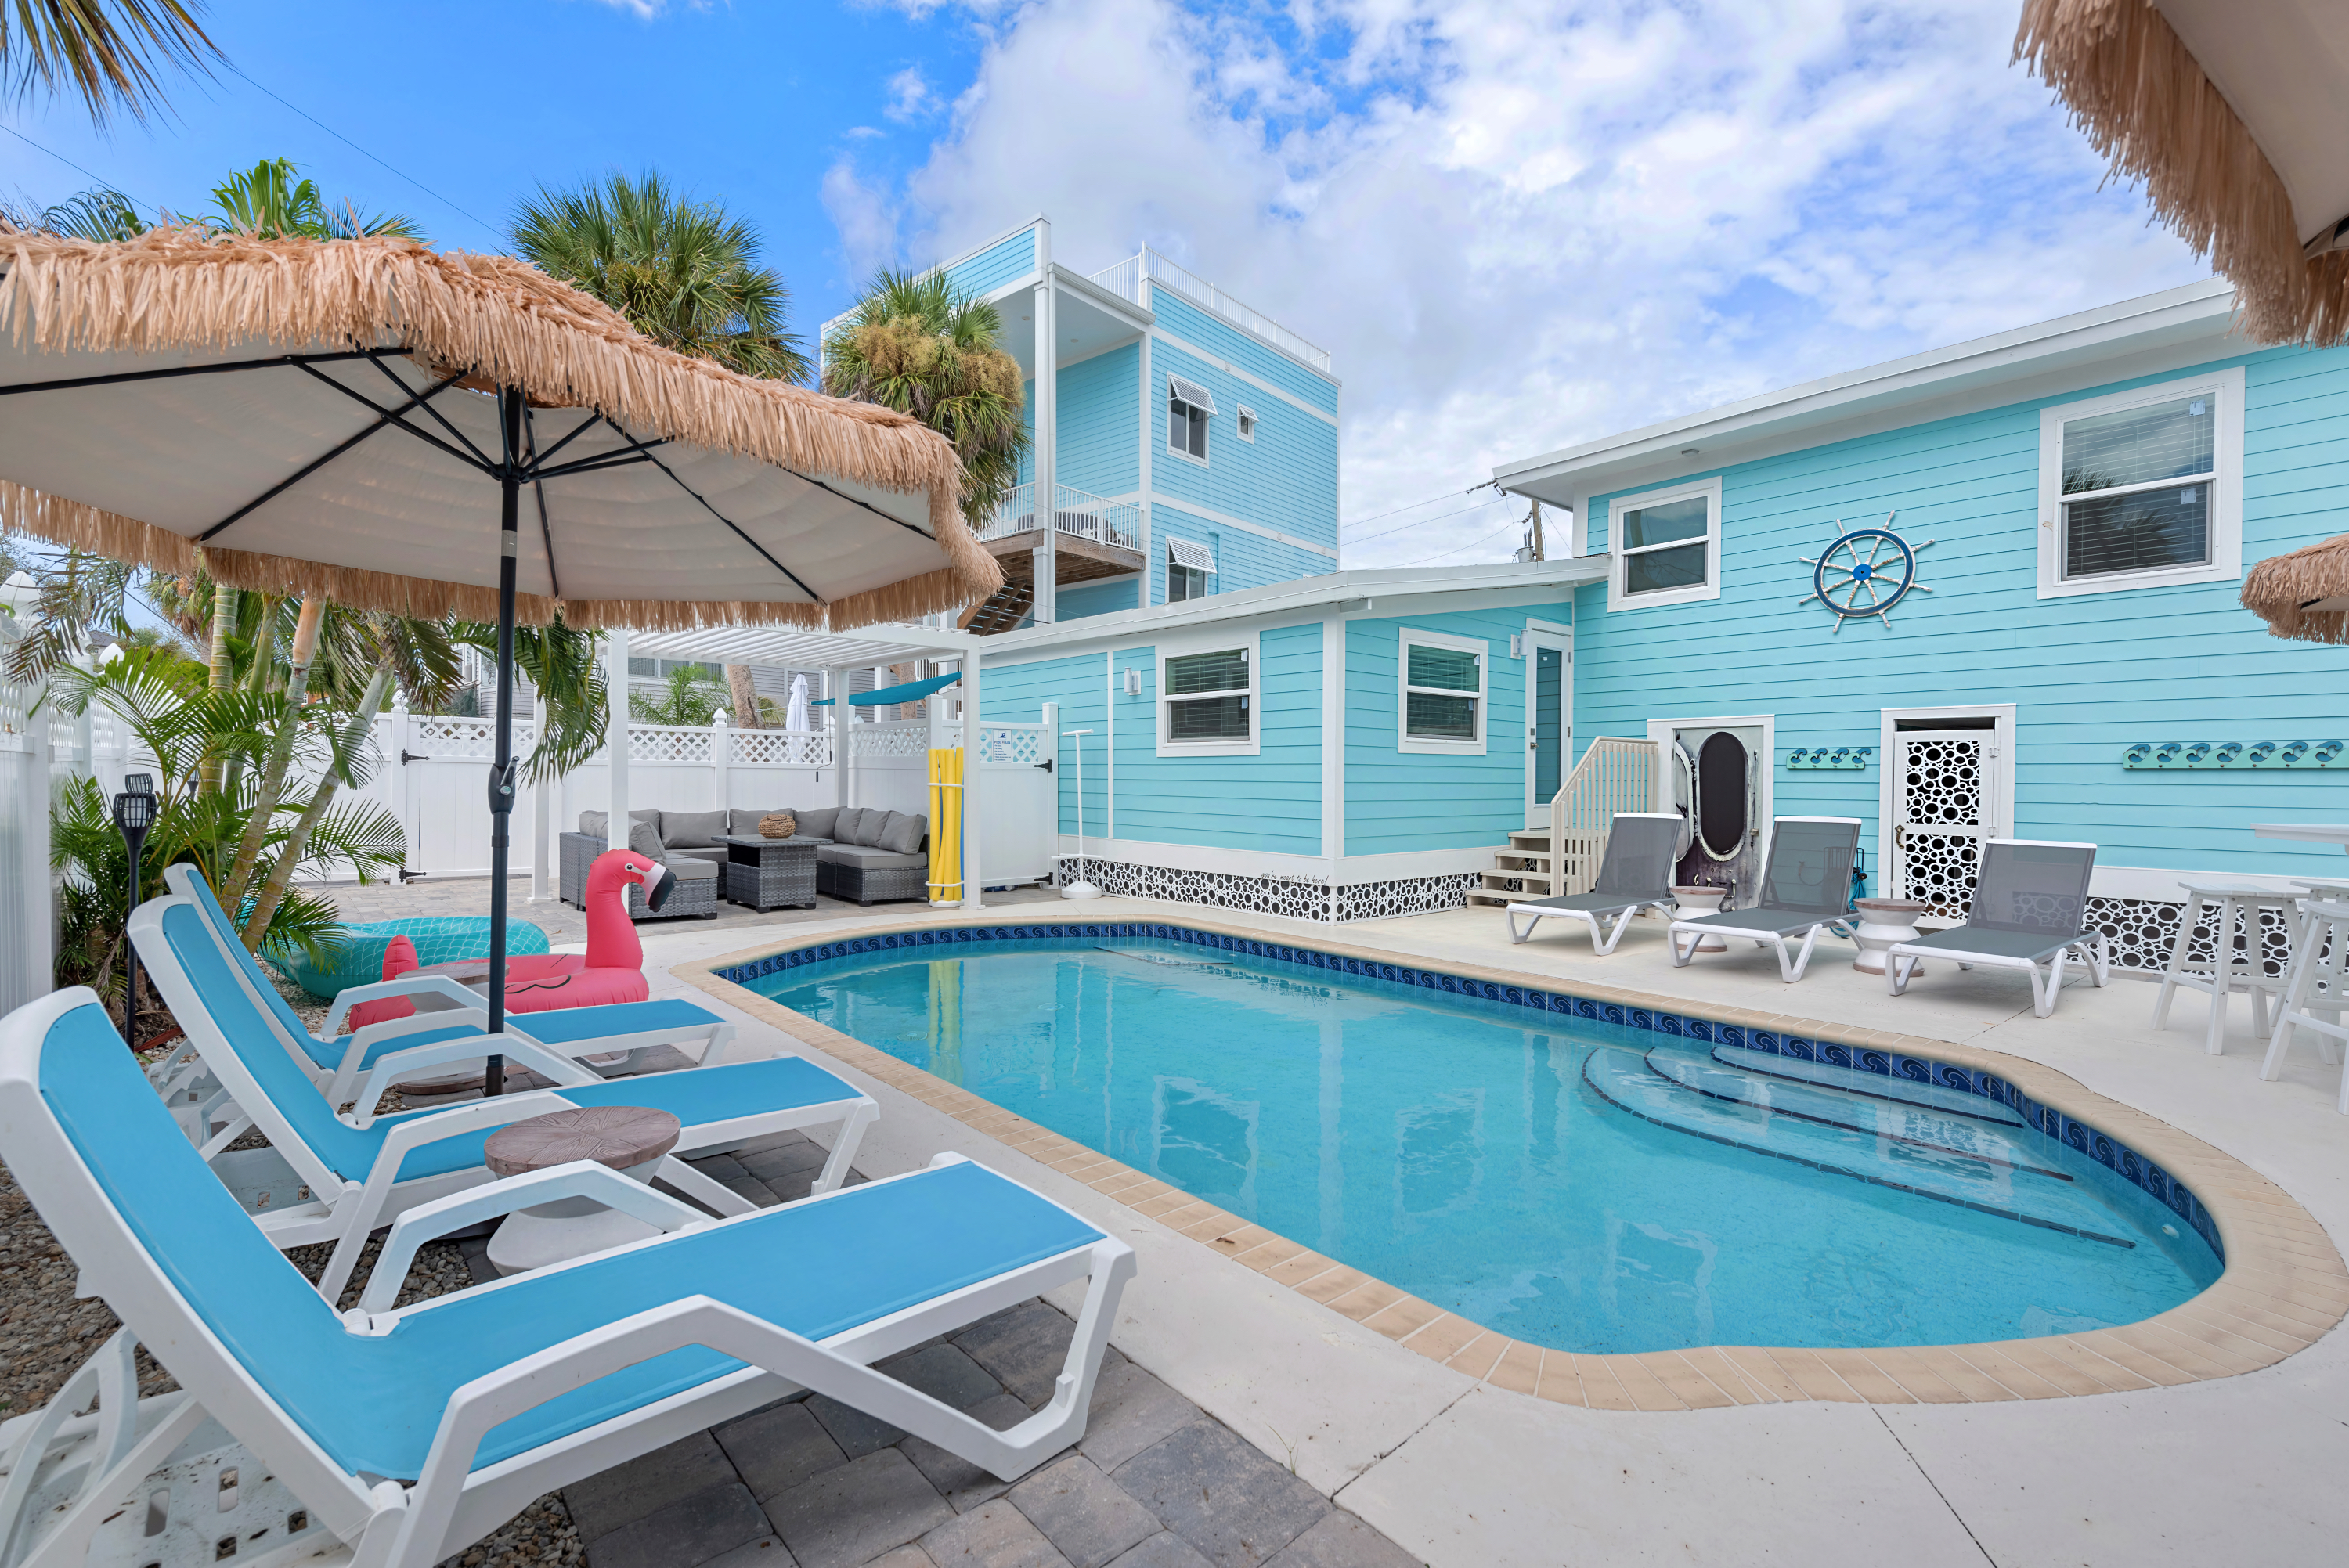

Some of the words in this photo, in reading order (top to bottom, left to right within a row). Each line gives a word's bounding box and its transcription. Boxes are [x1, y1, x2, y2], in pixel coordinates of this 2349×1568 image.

[1261, 870, 1277, 879] you're
[1303, 874, 1310, 883] be
[1311, 874, 1330, 885] here!
